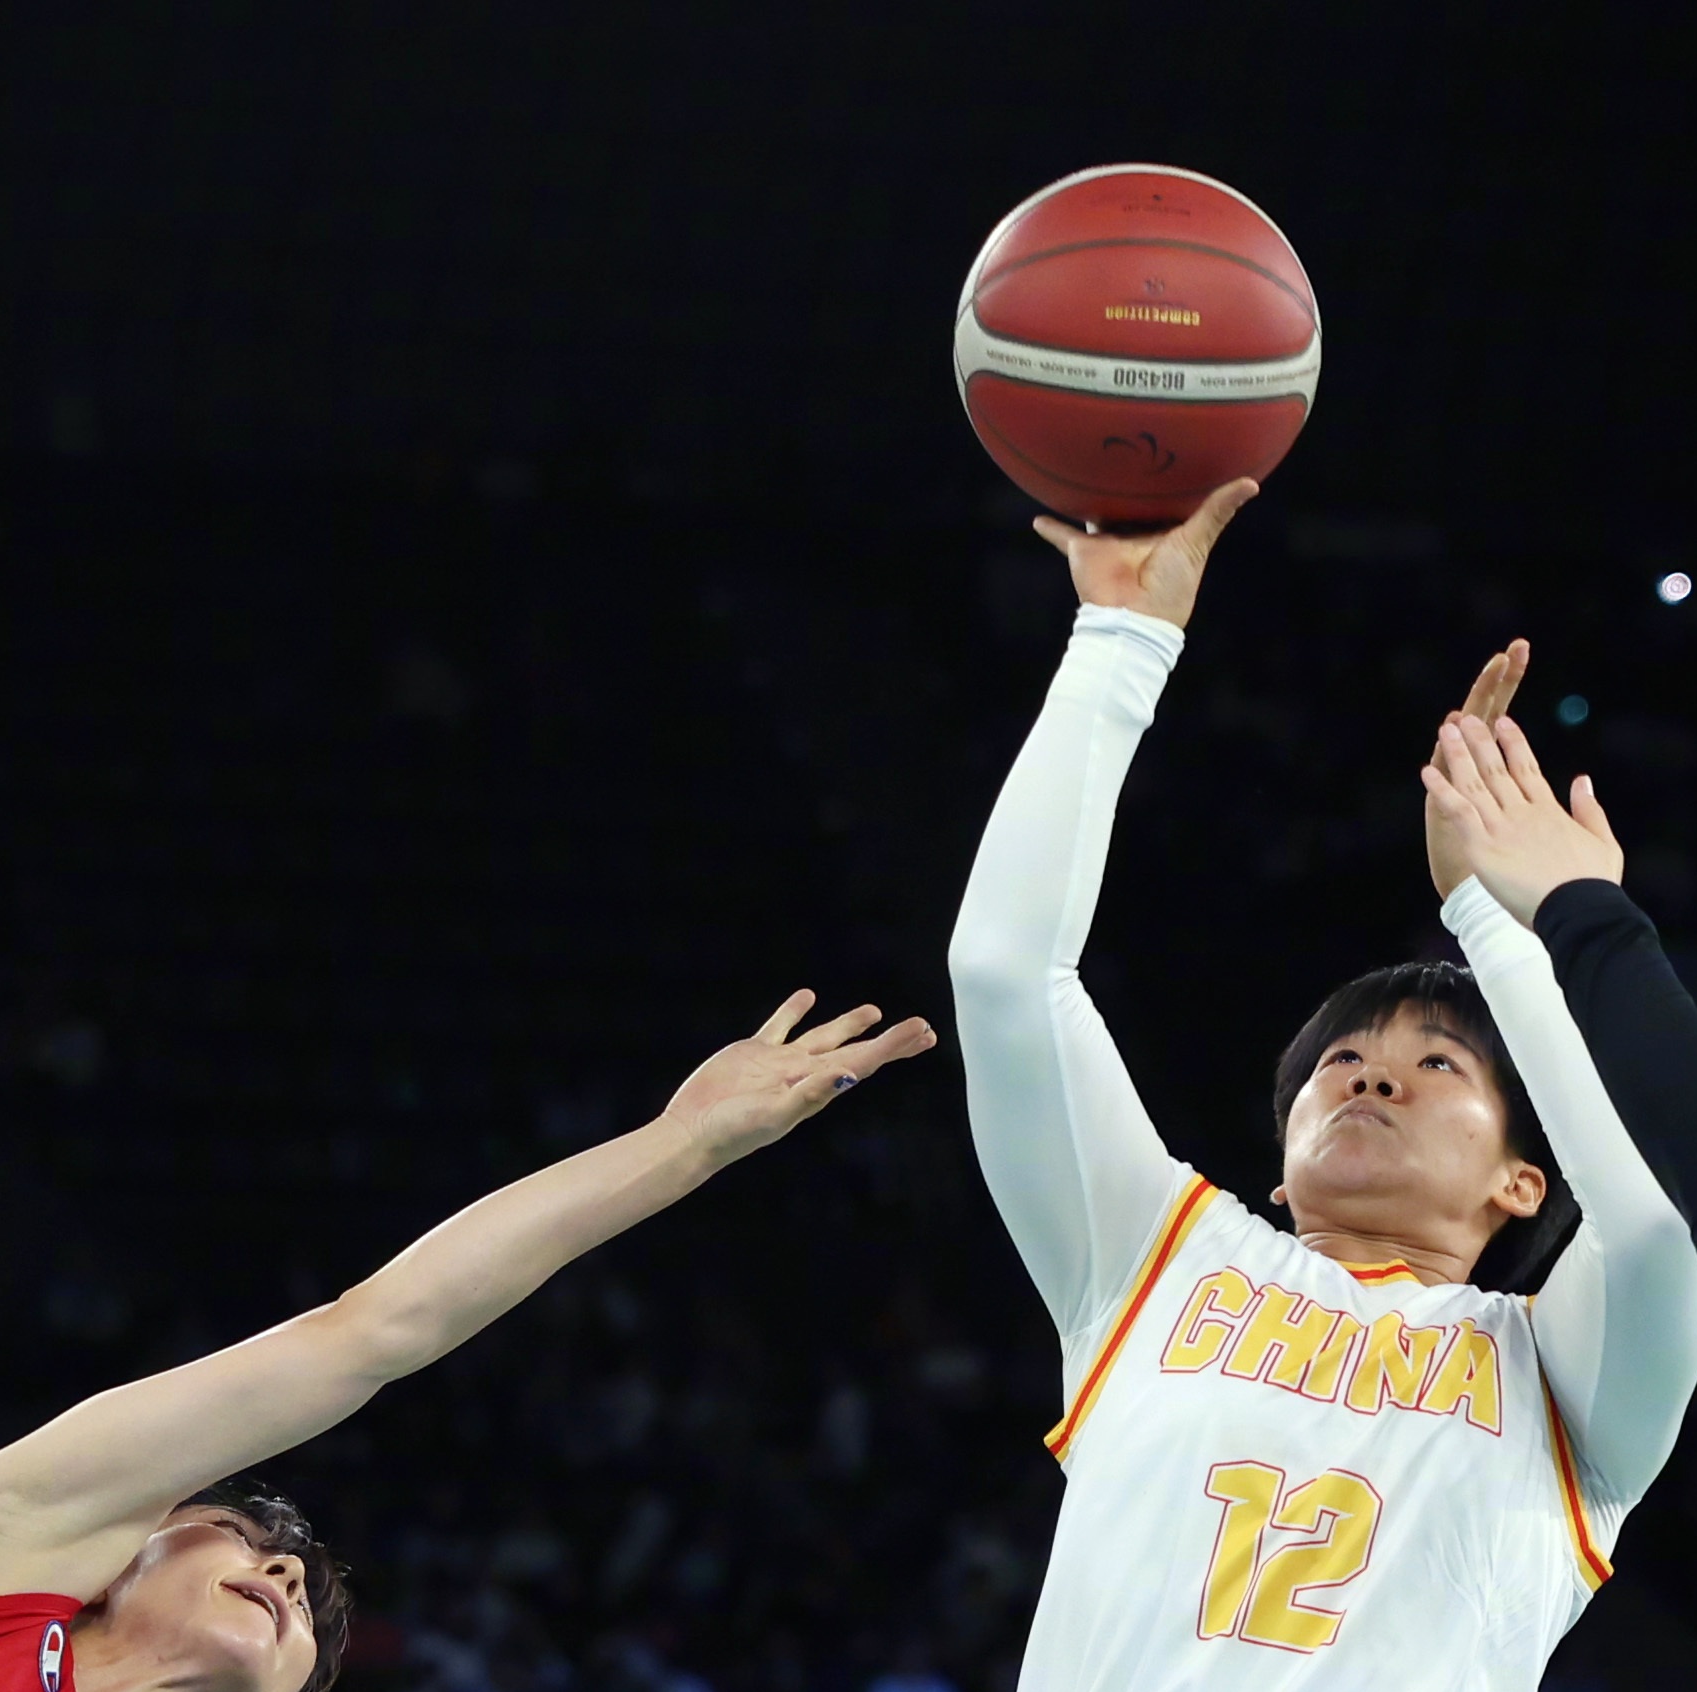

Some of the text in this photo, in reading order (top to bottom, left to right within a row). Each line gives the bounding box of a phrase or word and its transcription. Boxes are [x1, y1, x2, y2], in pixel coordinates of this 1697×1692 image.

[1113, 367, 1186, 391] BG4500
[1159, 1265, 1502, 1437] CHINA
[1197, 1459, 1383, 1654] 12
